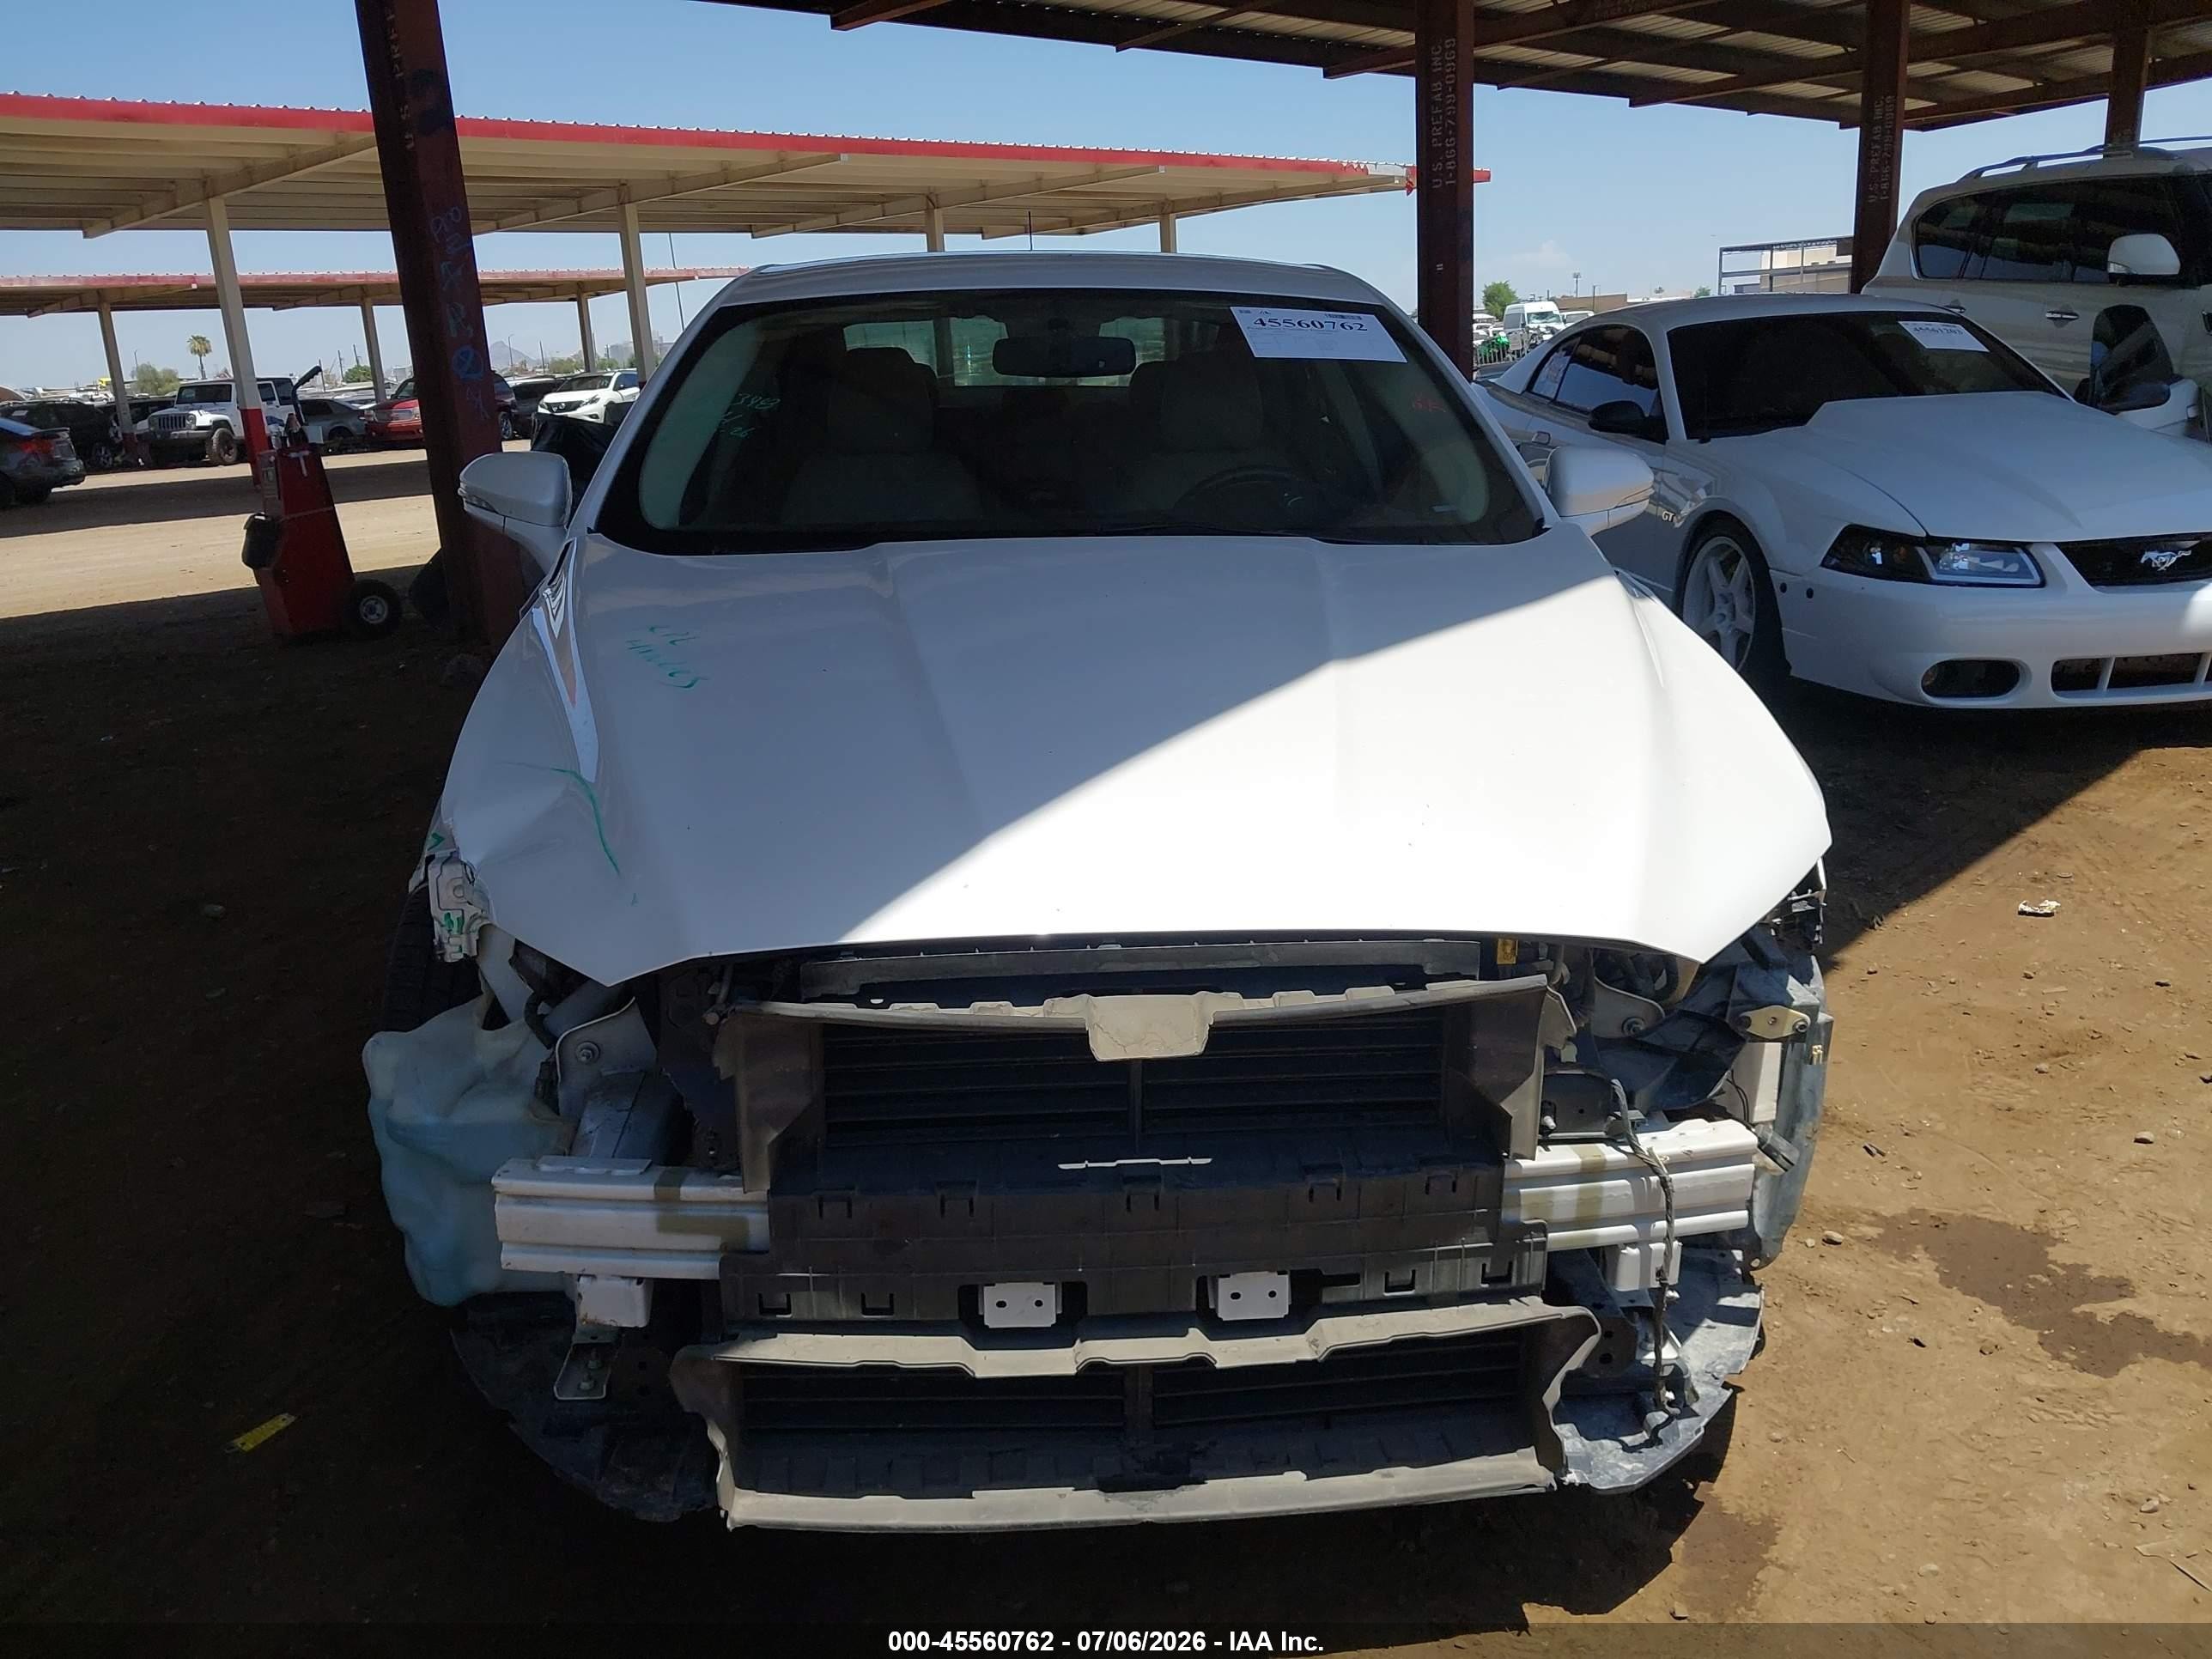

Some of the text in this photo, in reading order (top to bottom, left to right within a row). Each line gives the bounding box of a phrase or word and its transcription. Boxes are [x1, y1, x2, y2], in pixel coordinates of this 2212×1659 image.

[1431, 82, 1443, 148] PREFAB
[1869, 125, 1882, 173] PREFAB
[1431, 157, 1443, 189] U.S.
[1254, 317, 1368, 331] 45560762
[1662, 511, 1674, 522] GT
